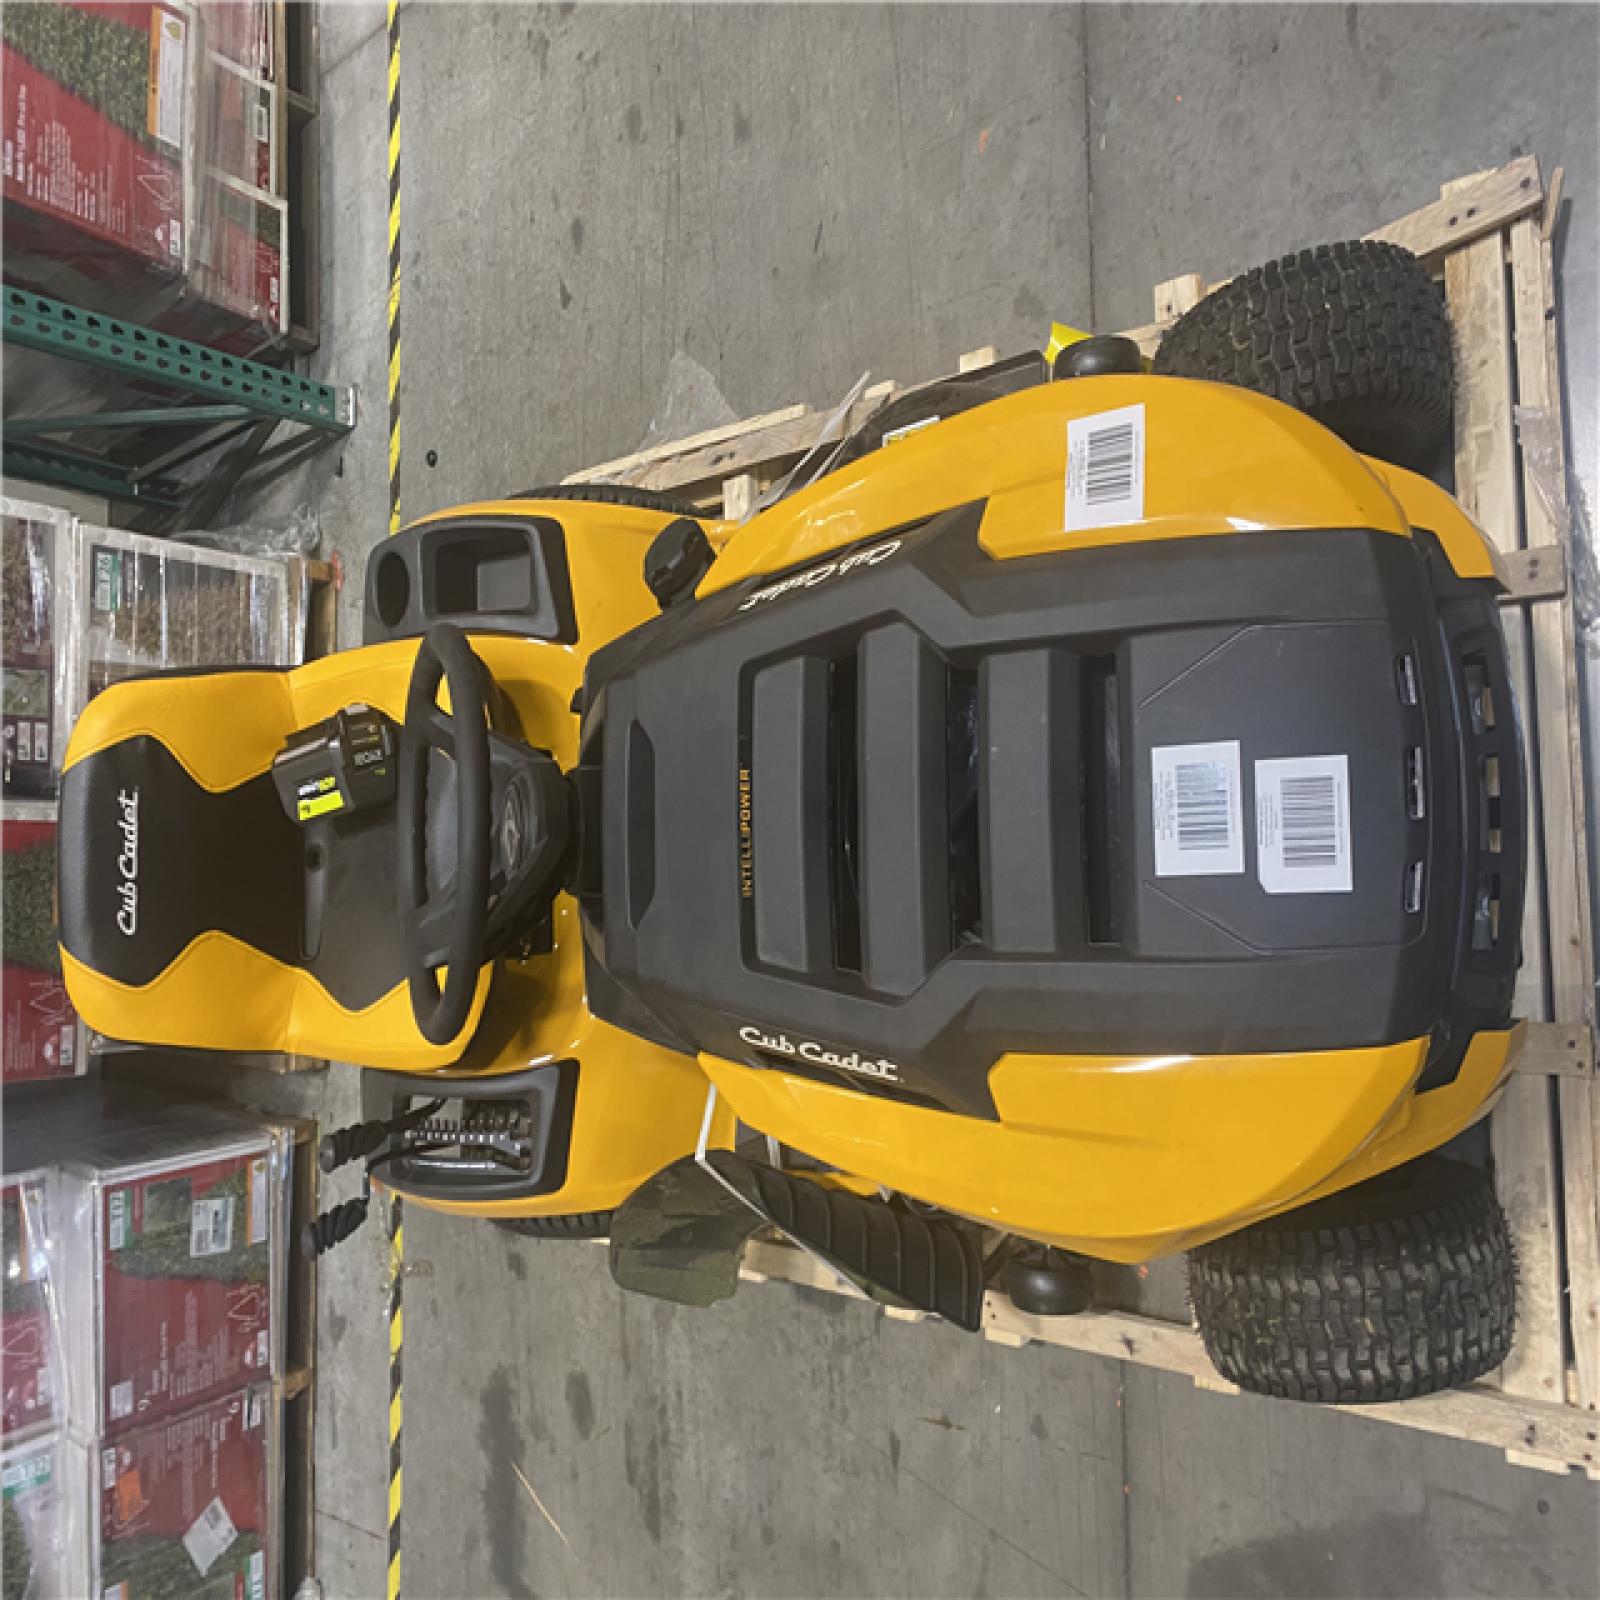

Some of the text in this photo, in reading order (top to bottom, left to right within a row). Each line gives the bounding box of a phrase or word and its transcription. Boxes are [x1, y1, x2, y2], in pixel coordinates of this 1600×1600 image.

[737, 539, 901, 611] Cub Cadet
[116, 788, 139, 936] Cub Cadet
[739, 1026, 899, 1081] Cub Cadet
